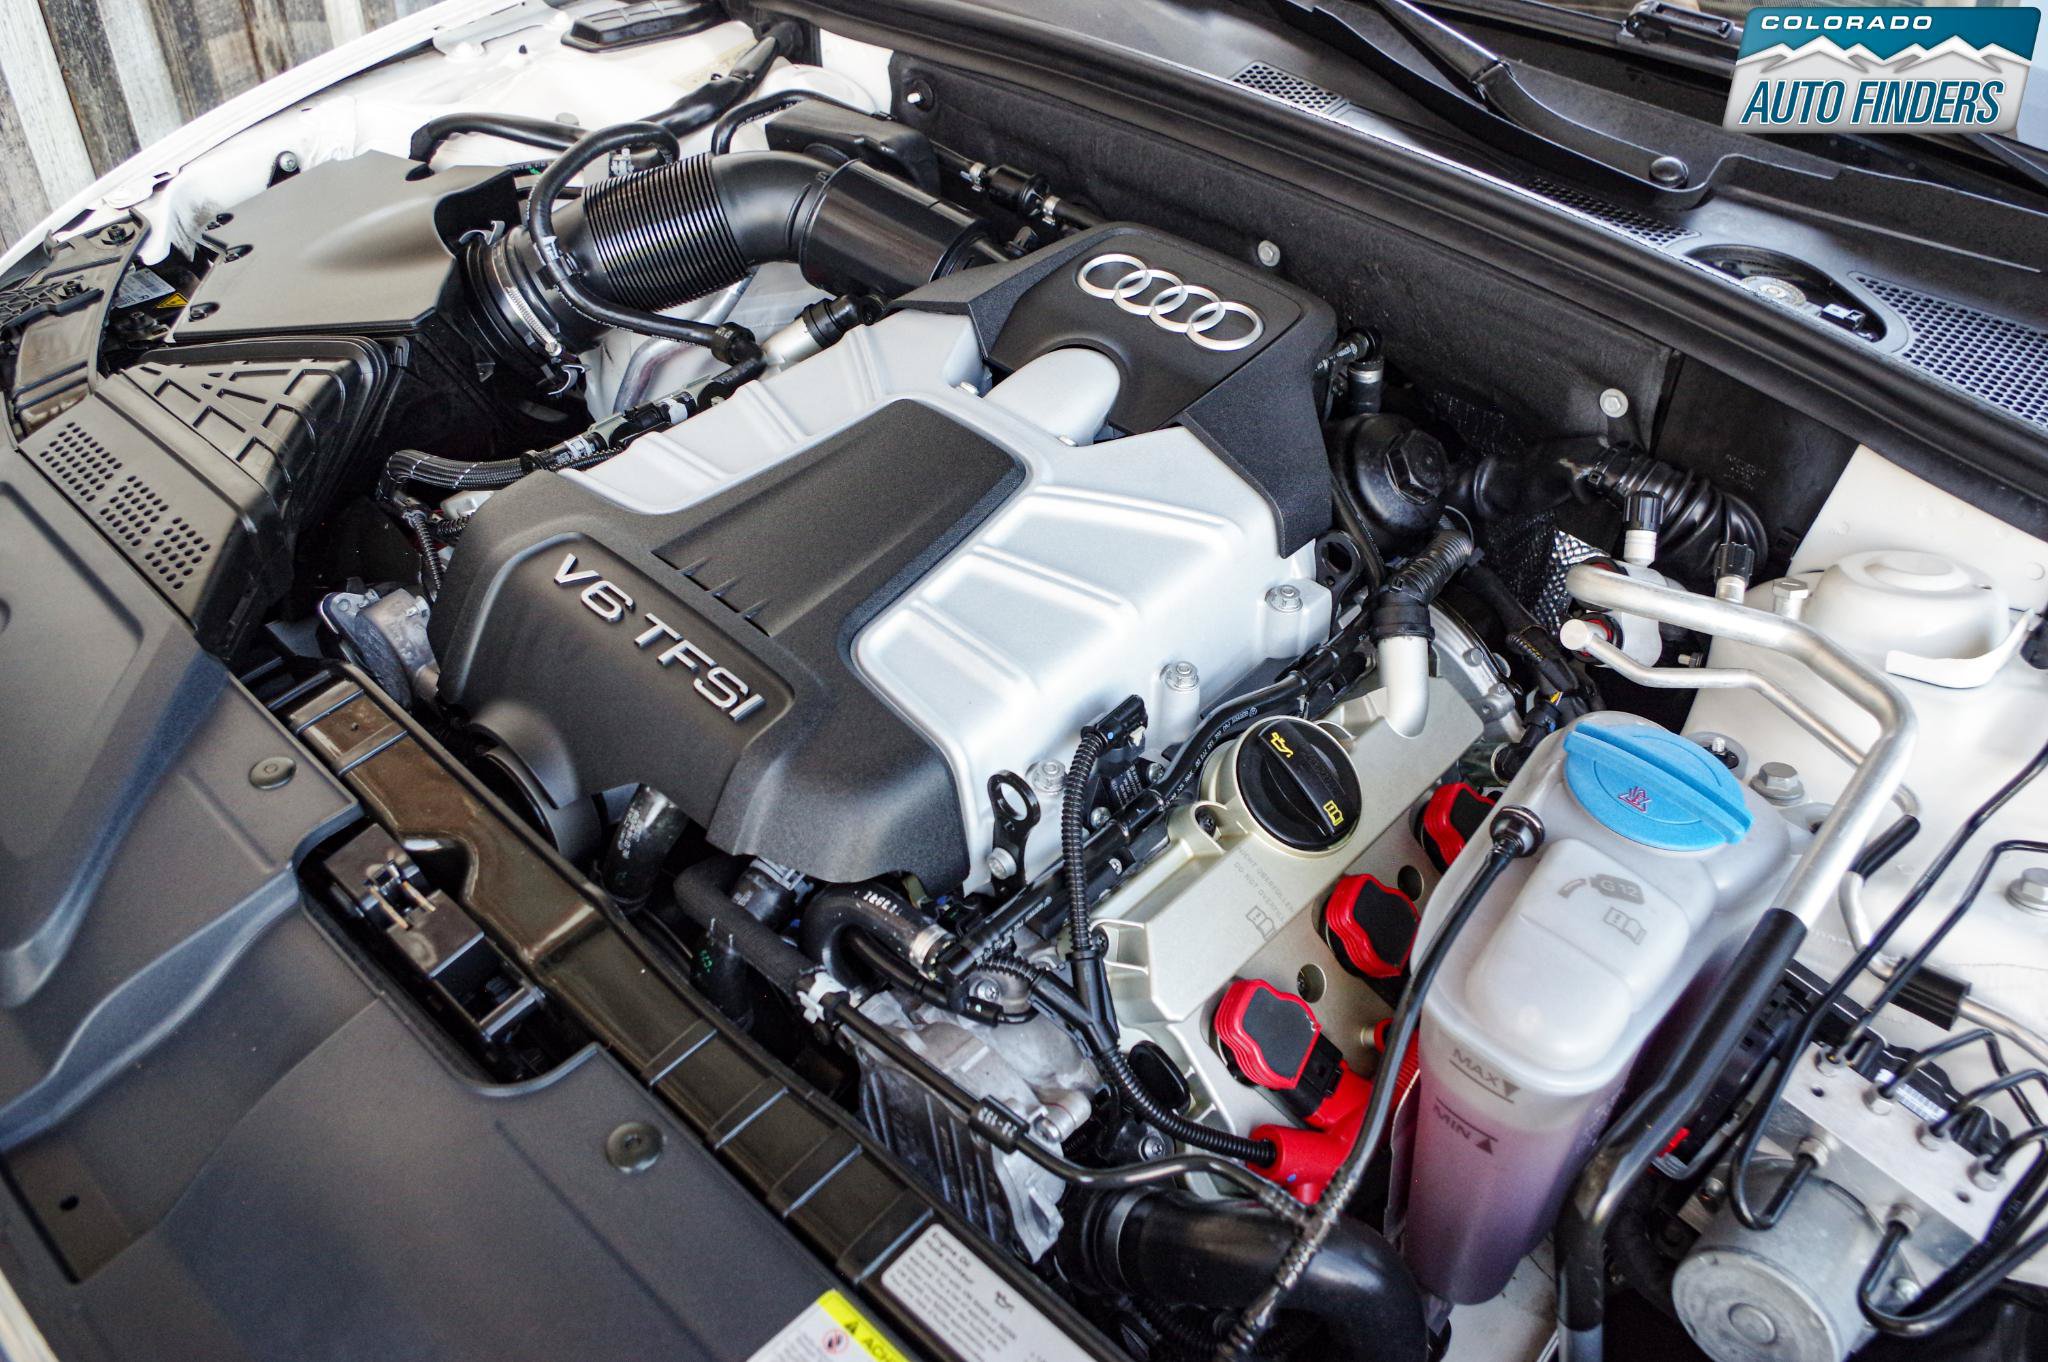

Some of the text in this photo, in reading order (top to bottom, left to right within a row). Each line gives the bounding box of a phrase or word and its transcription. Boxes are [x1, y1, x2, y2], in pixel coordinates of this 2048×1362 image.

[554, 553, 767, 722] V6 TFSI
[1453, 1048, 1500, 1087] MAX
[1432, 1103, 1472, 1140] MIN
